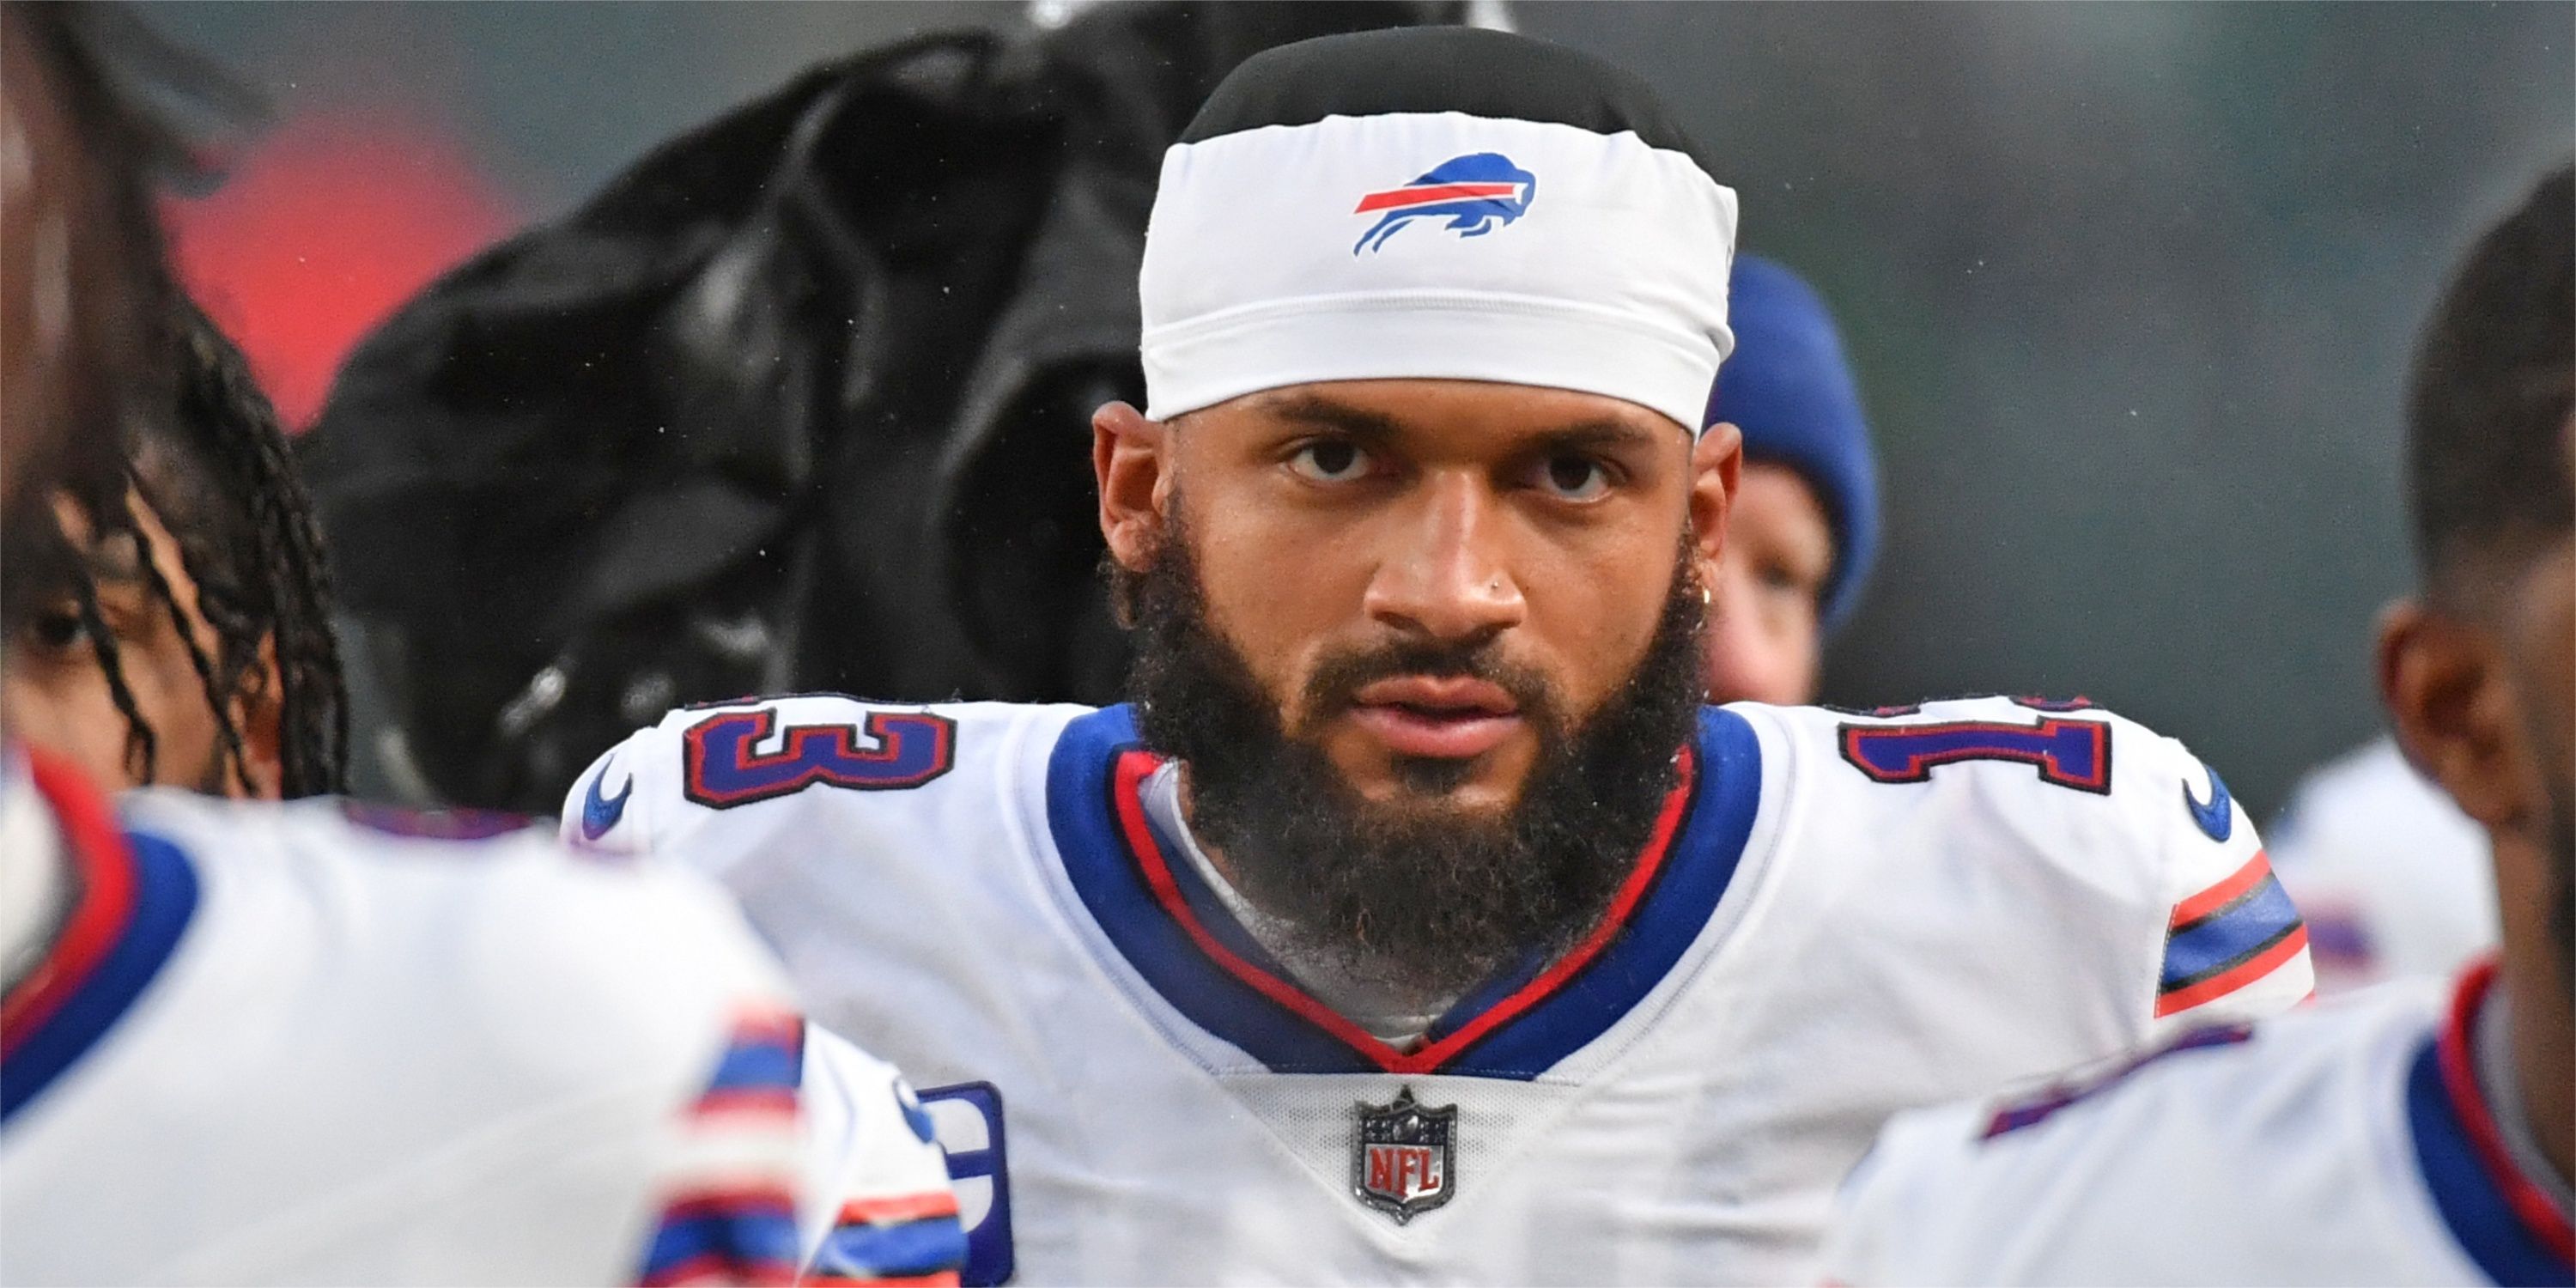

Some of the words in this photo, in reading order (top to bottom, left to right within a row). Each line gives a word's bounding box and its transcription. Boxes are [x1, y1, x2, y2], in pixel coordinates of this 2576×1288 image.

[683, 692, 957, 810] 3
[1822, 693, 2111, 796] 1
[1368, 1147, 1439, 1198] NFL
